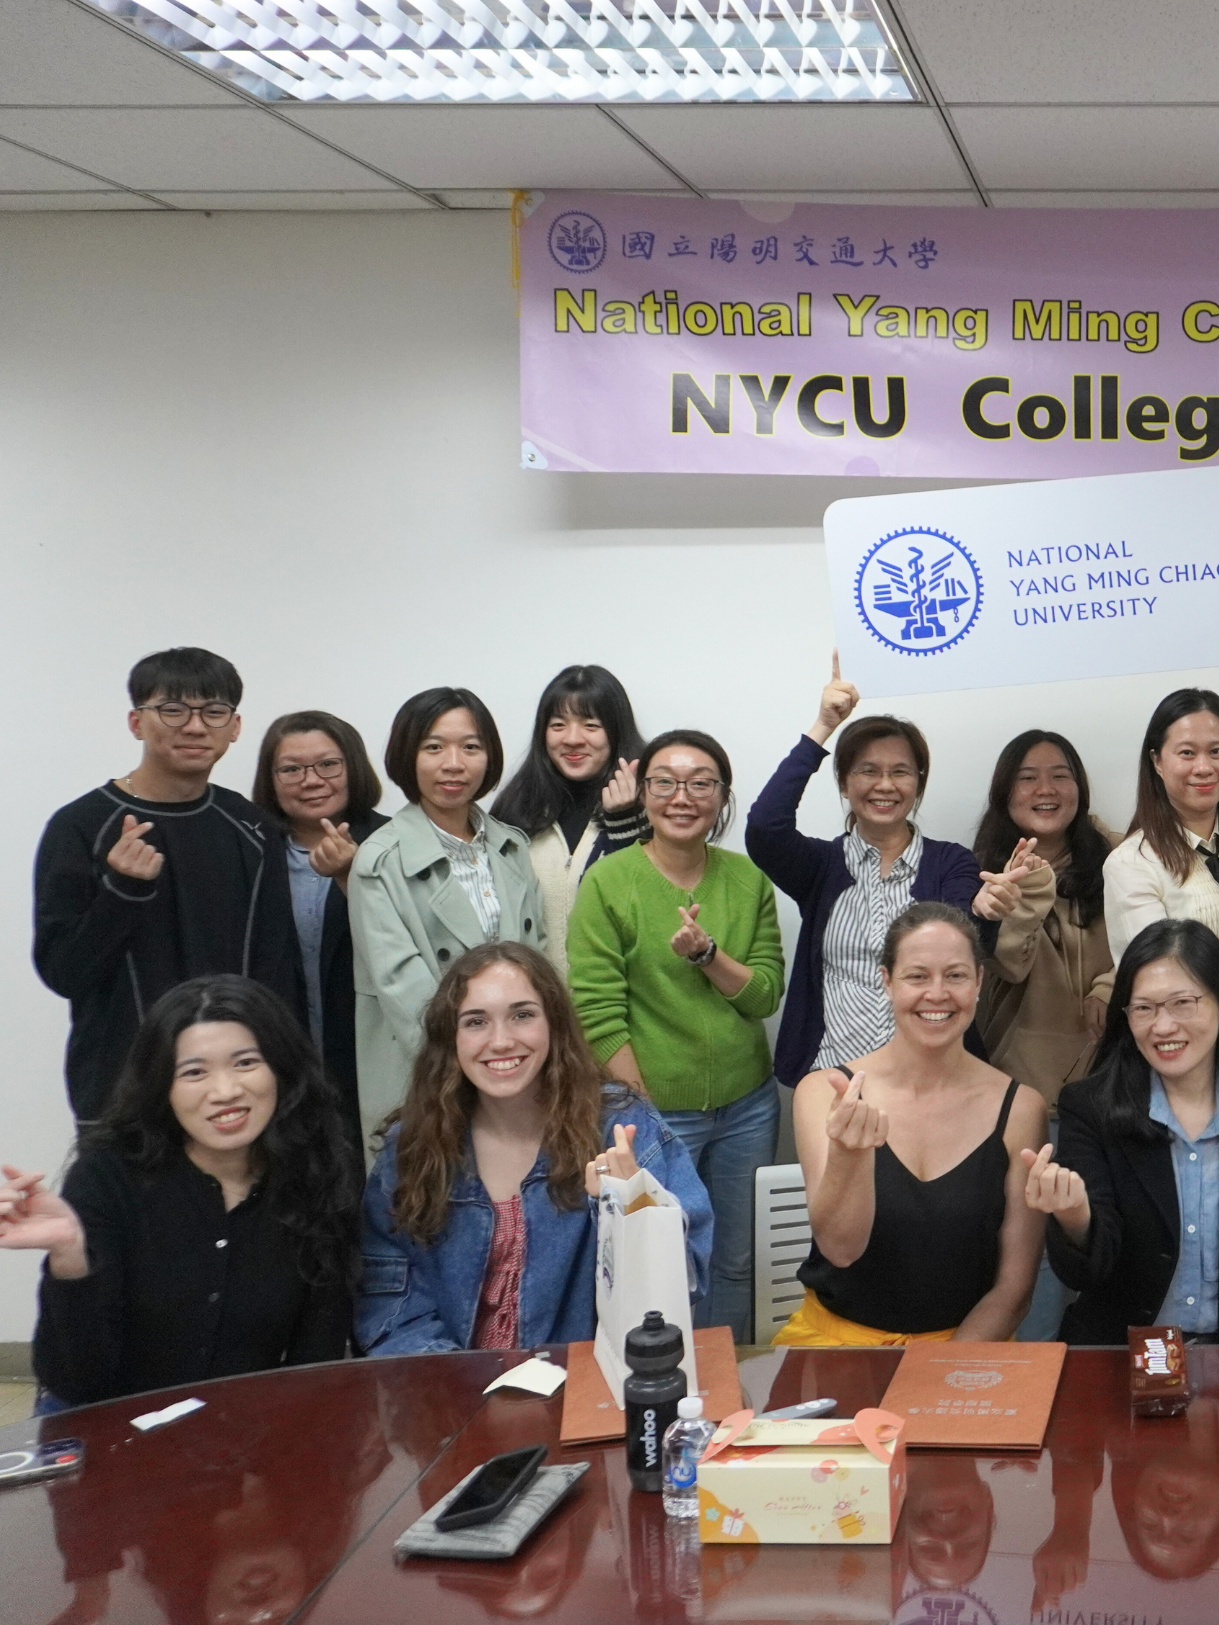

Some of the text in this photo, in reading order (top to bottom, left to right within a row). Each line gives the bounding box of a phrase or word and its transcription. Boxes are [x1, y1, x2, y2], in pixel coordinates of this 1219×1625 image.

[621, 229, 939, 270] 國立陽明交通大學
[553, 288, 813, 337] National
[833, 293, 989, 351] Yang
[1011, 299, 1160, 353] Ming
[669, 371, 908, 440] NYCU
[1006, 540, 1133, 568] NATIONAL
[1008, 573, 1077, 598] YANG
[1086, 568, 1150, 592] MING
[1012, 596, 1158, 626] UNIVERSITY
[639, 1408, 658, 1468] wahoo
